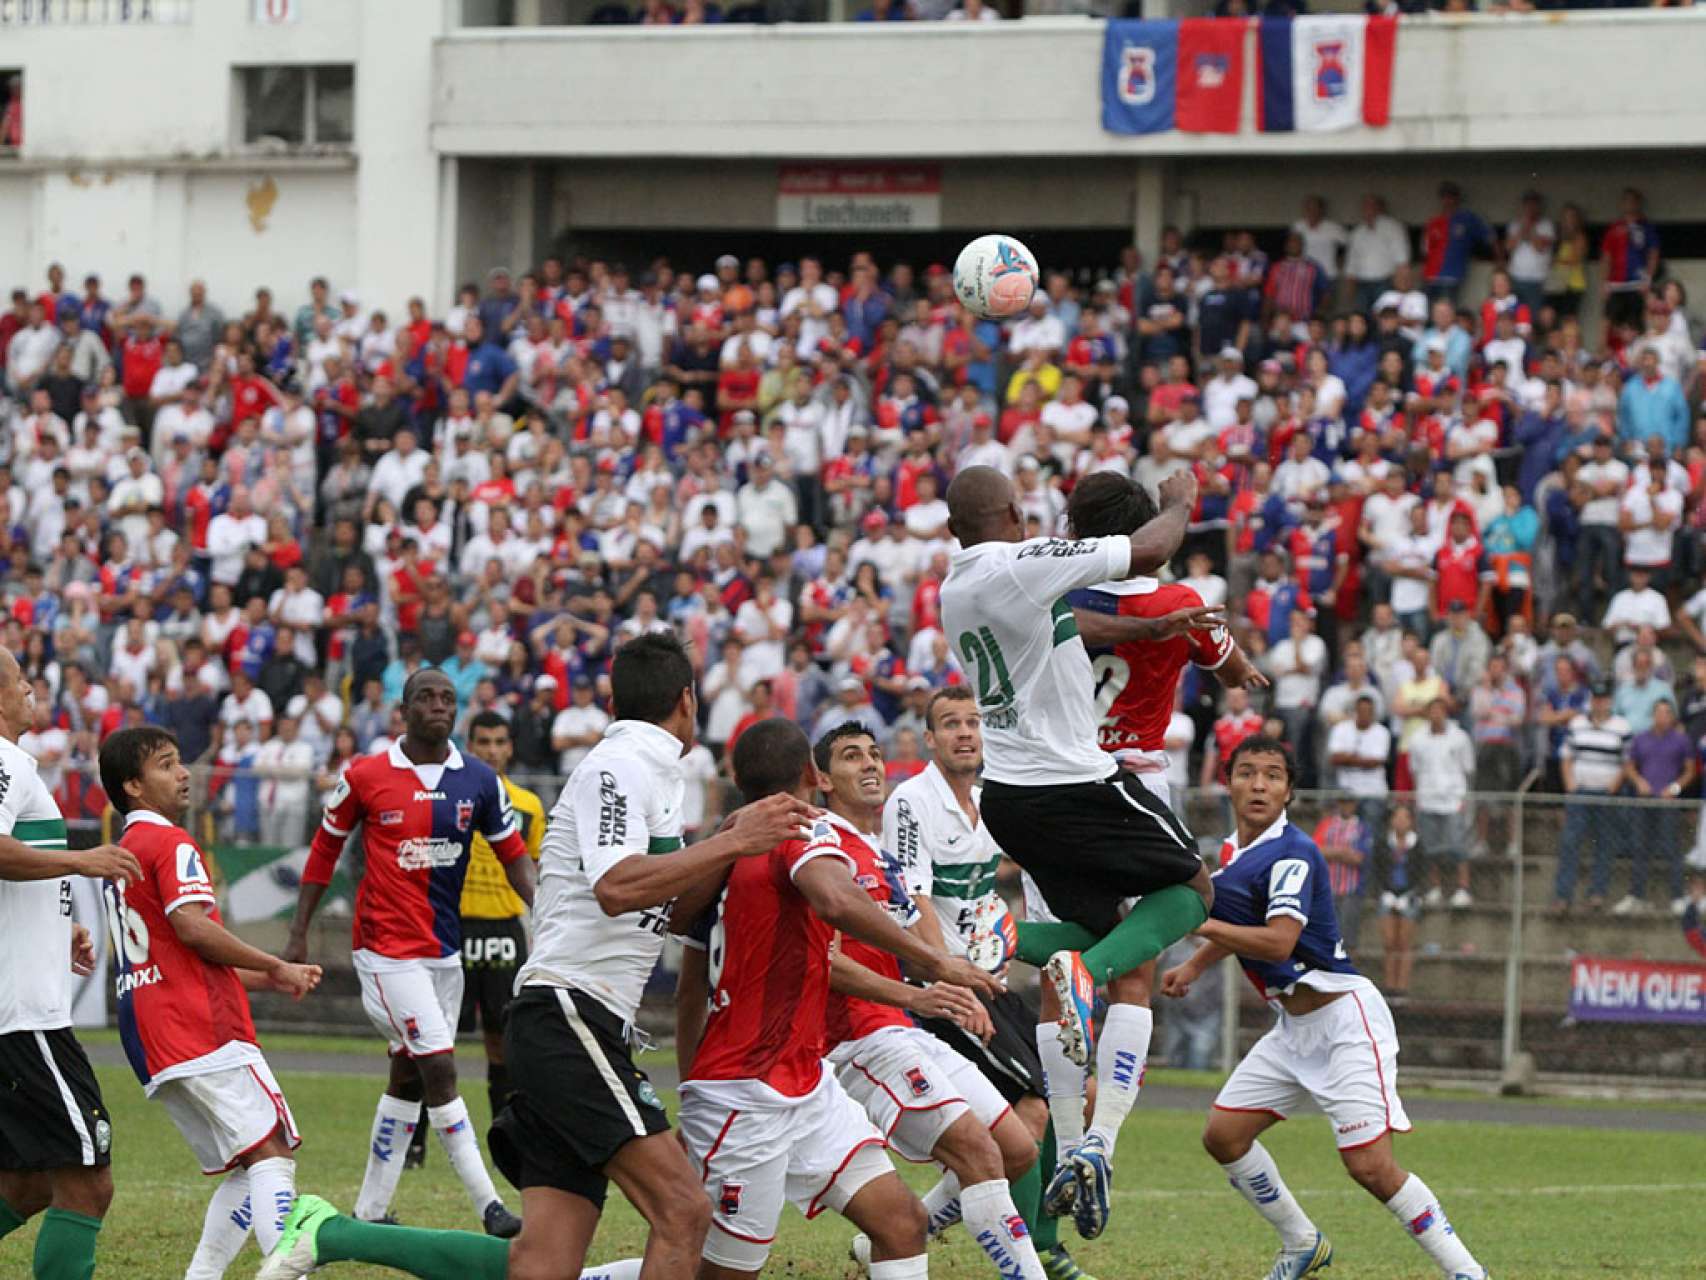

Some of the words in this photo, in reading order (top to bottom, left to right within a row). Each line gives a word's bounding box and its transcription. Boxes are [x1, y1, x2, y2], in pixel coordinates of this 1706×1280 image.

[960, 626, 1014, 705] 21
[611, 794, 627, 847] TORK
[1573, 964, 1640, 1007] NEM
[1645, 974, 1701, 1011] QUE
